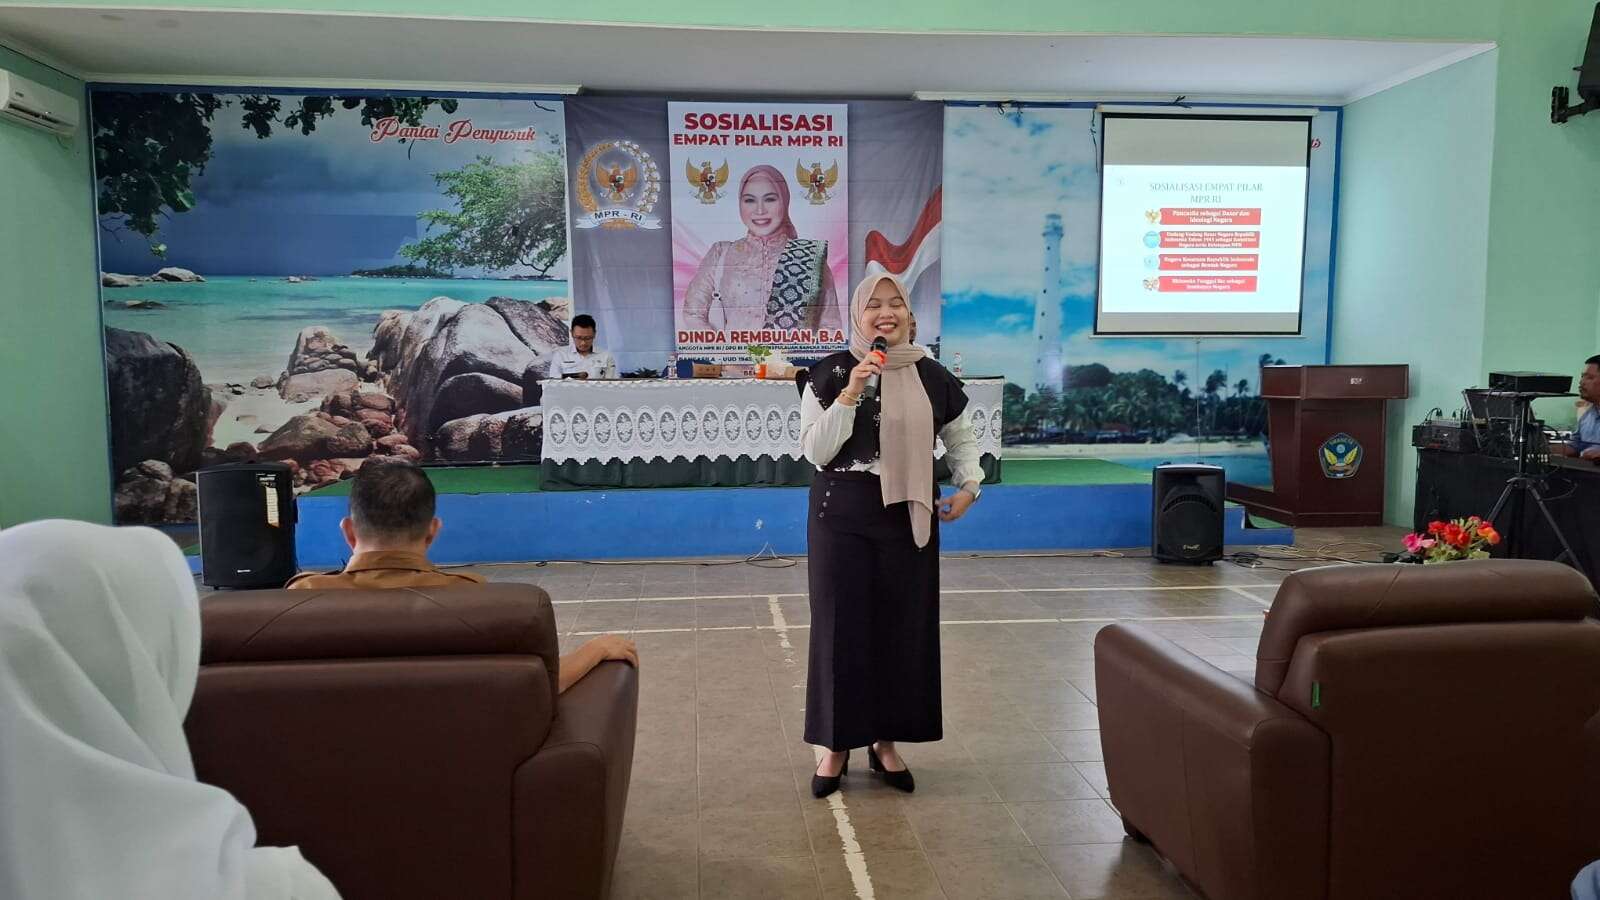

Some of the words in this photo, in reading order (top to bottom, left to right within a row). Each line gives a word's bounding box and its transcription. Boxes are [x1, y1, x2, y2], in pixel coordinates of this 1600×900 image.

[684, 113, 833, 131] SOSIALISASI
[371, 117, 440, 141] Pantai
[444, 118, 536, 144] Penyusuk
[674, 134, 730, 146] EMPAT
[735, 135, 782, 146] PILAR
[788, 136, 822, 146] MPR
[828, 136, 843, 147] RI
[1150, 183, 1202, 192] SOSIALISASI
[1205, 183, 1234, 192] EMPAT
[1237, 183, 1264, 192] PILAR
[1191, 195, 1210, 203] MPR
[1212, 195, 1222, 203] RI
[594, 211, 619, 219] MPR
[630, 213, 642, 221] RI
[678, 331, 726, 343] DINDA
[731, 331, 816, 345] REMBULAN,
[819, 331, 844, 343] B.A
